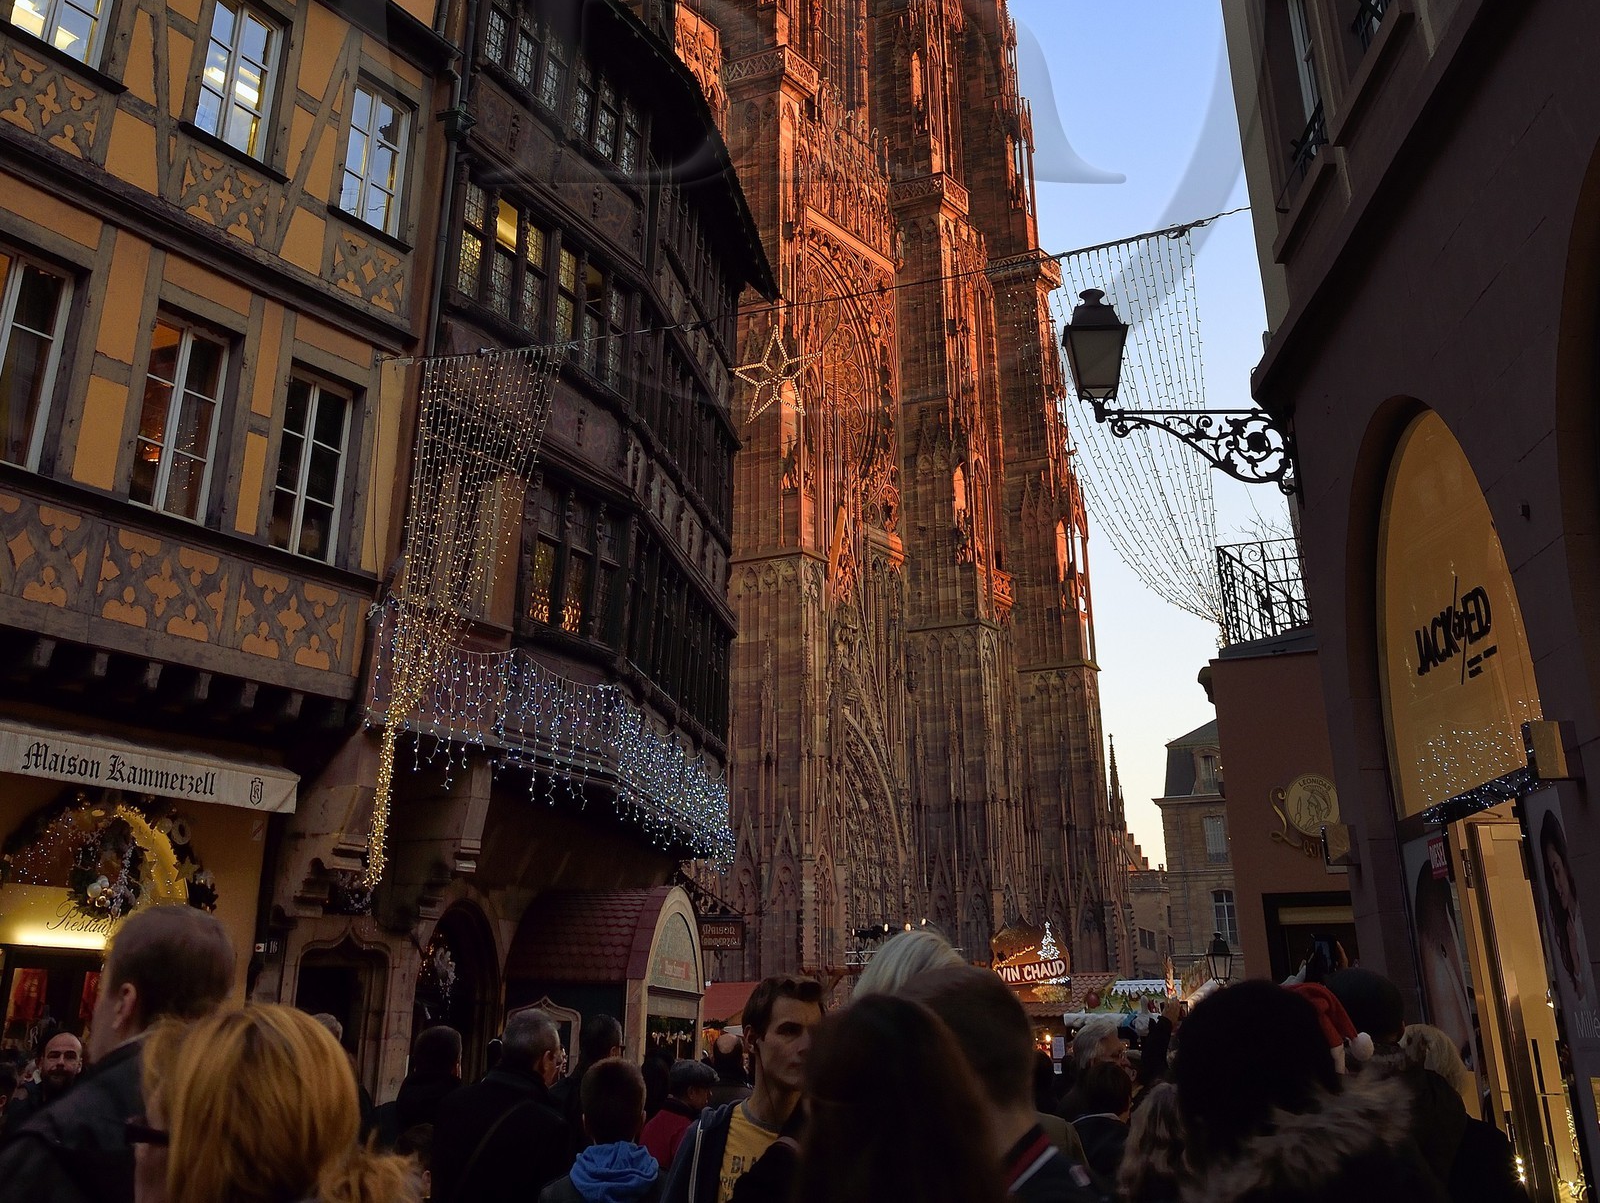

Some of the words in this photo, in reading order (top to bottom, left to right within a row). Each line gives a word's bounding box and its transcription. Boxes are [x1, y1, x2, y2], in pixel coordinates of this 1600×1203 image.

[22, 741, 101, 780] Maison
[106, 754, 216, 797] Kammerzell
[1298, 778, 1332, 791] LEONIDAS
[46, 899, 111, 936] Restau
[997, 965, 1021, 982] VIN
[1023, 960, 1066, 981] CHAUD
